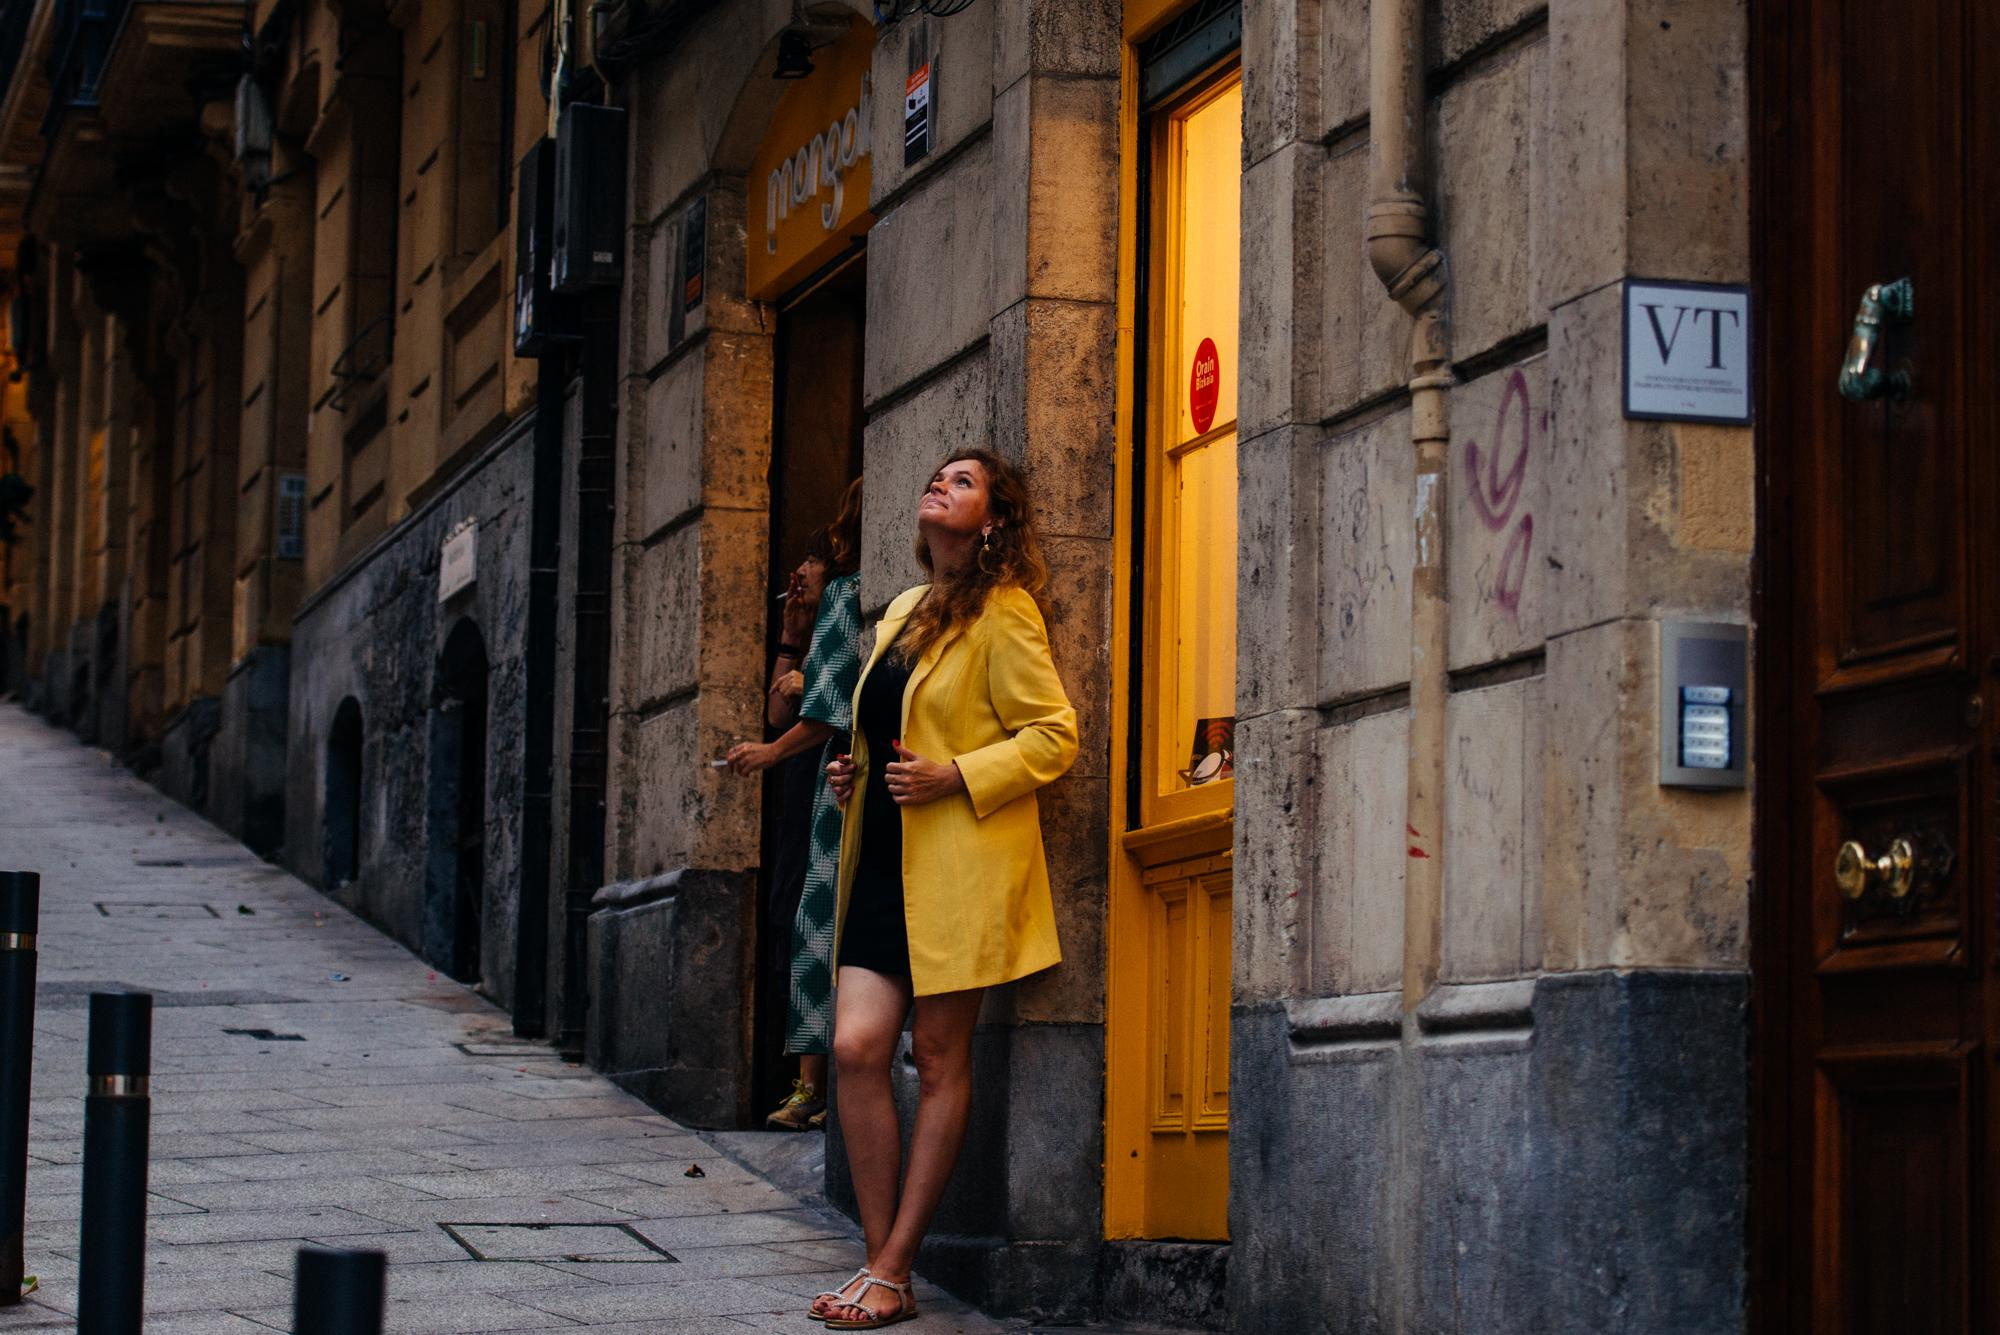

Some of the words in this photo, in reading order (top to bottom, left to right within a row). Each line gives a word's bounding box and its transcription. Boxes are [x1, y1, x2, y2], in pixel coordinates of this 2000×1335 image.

[1638, 303, 1740, 370] VT
[1196, 355, 1215, 377] Orain
[1195, 373, 1214, 392] Bizkaia
